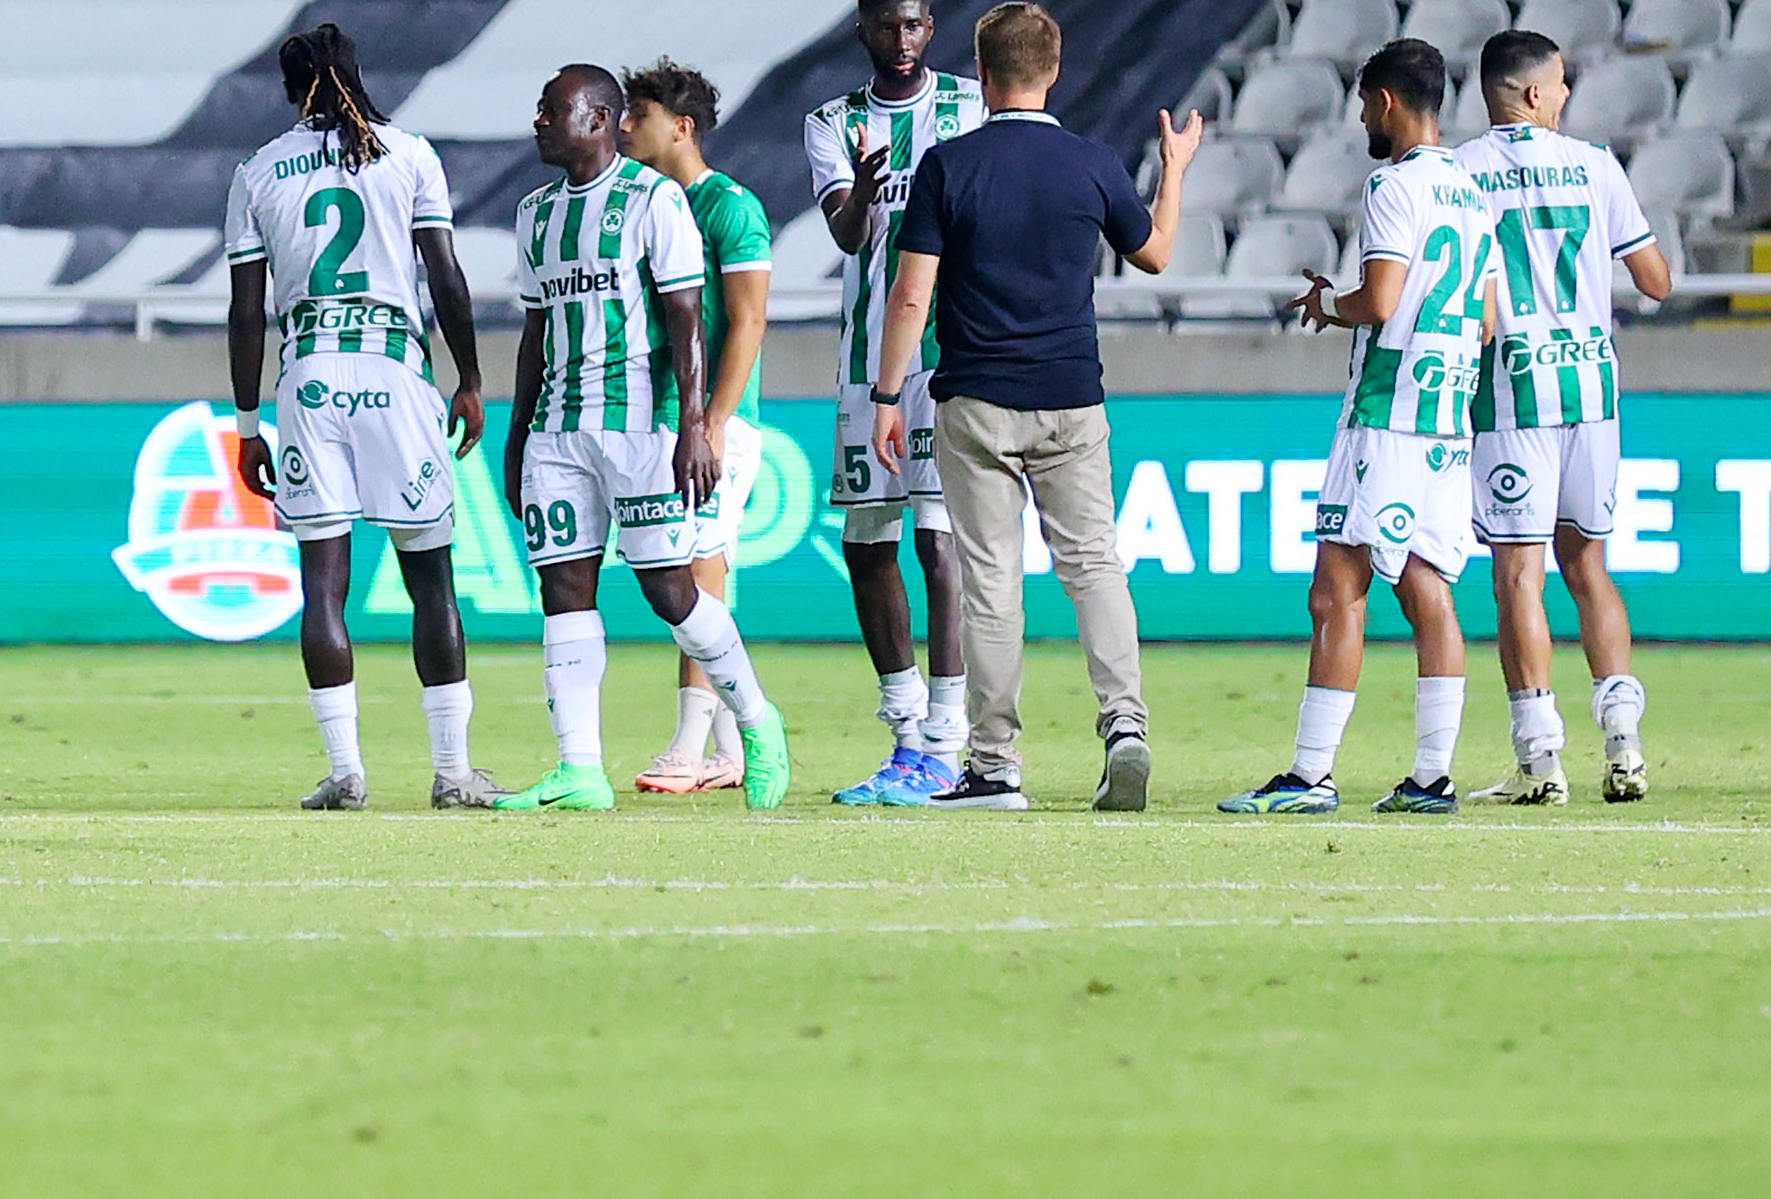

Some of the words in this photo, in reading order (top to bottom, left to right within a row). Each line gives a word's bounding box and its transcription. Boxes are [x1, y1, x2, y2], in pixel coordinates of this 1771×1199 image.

[1472, 166, 1588, 192] MASOURAS
[305, 187, 369, 297] 2
[1496, 205, 1590, 317] 17
[332, 388, 390, 417] cyta
[401, 460, 434, 512] Line
[844, 445, 871, 493] 5
[525, 499, 577, 551] 99
